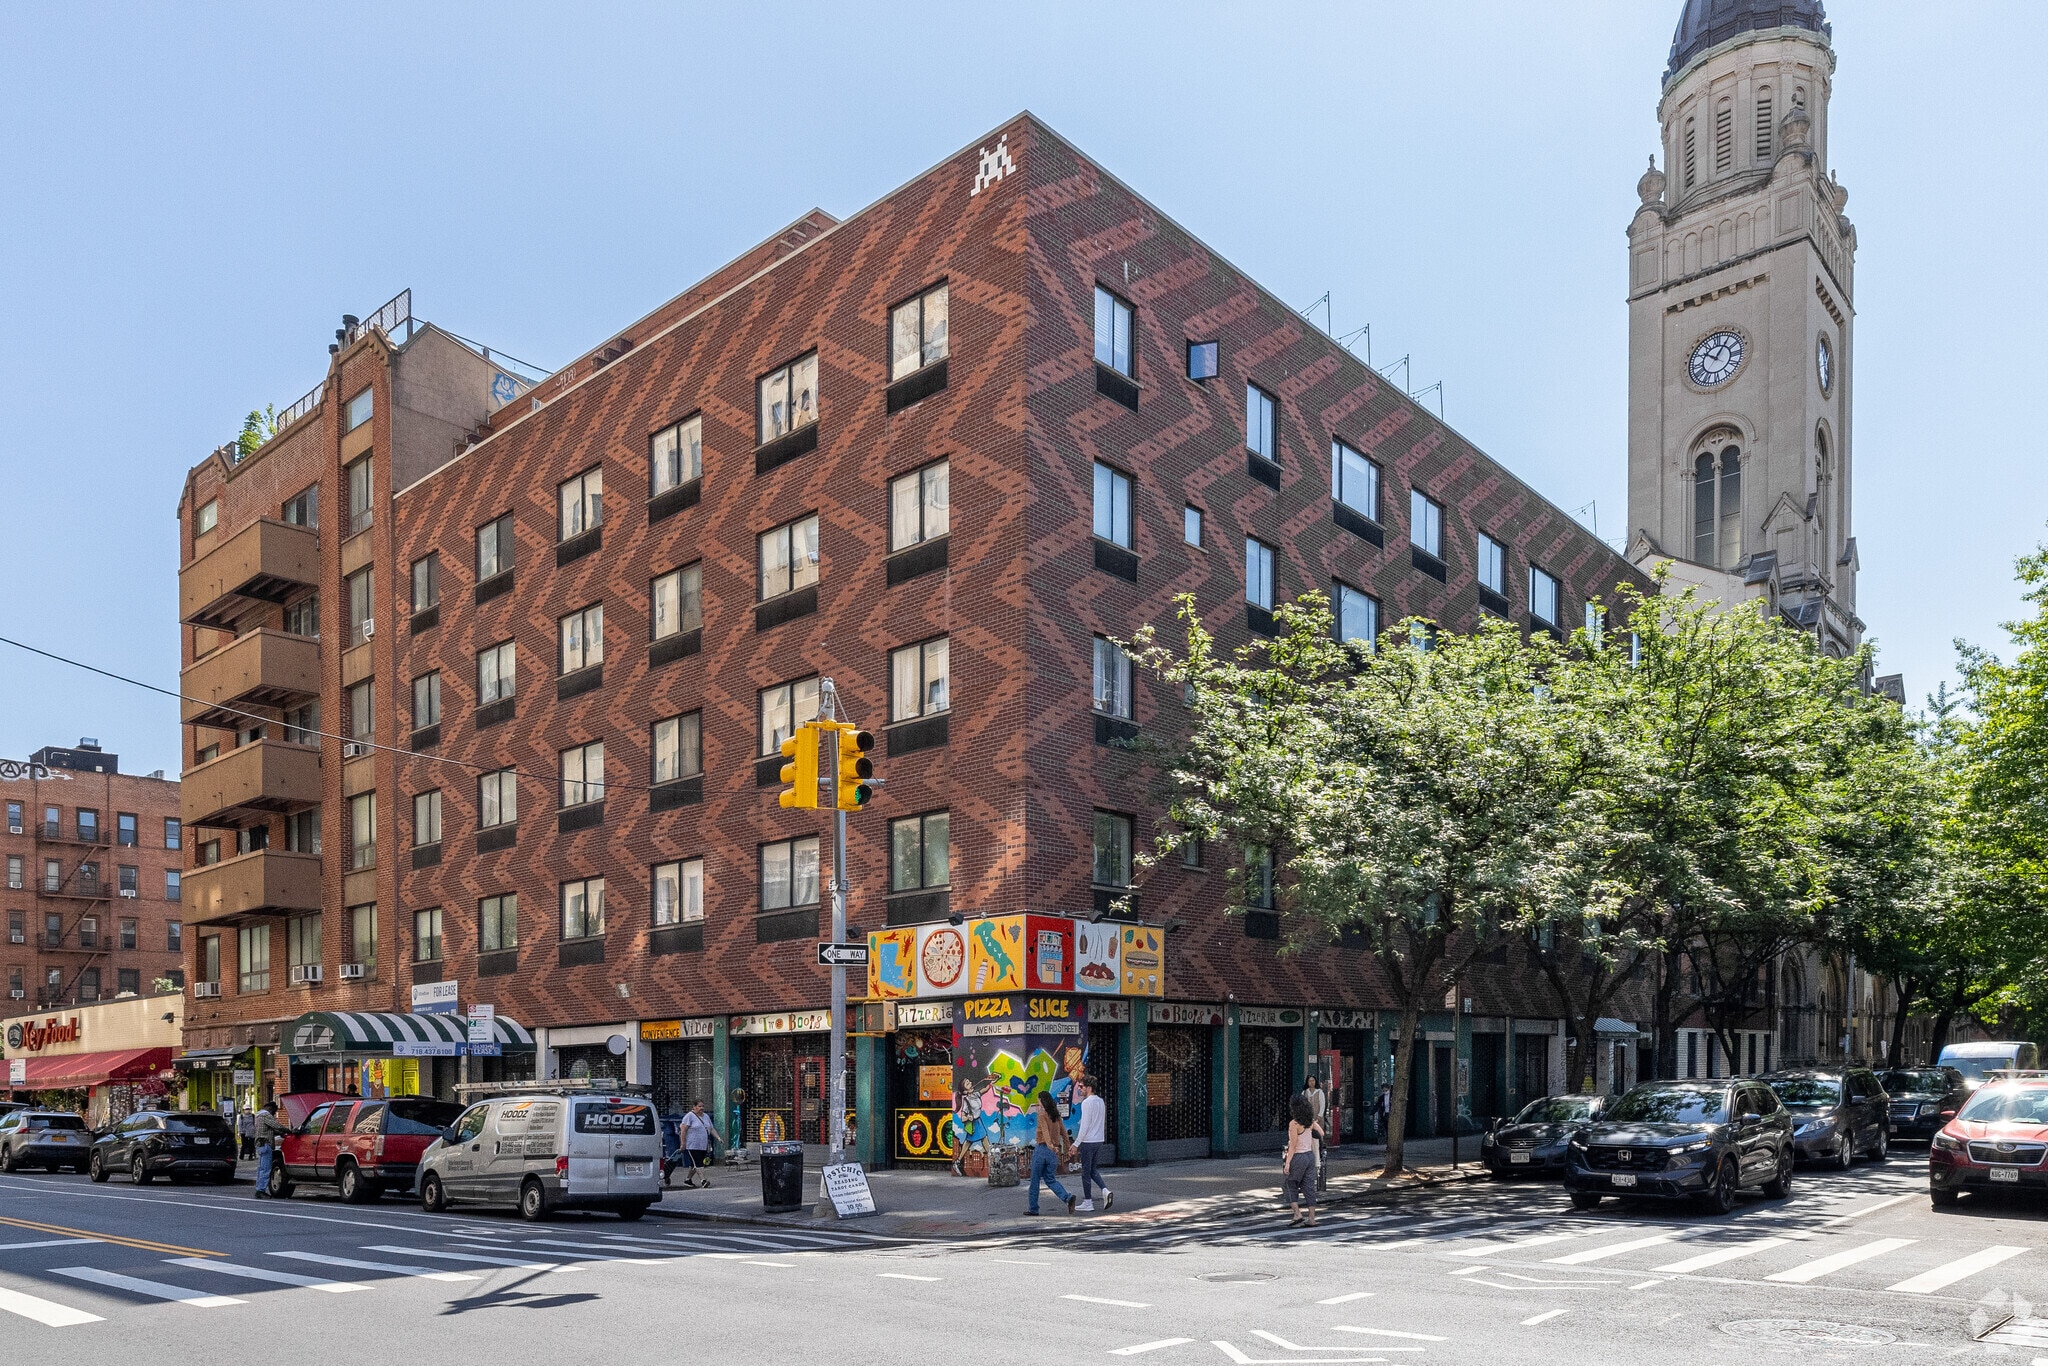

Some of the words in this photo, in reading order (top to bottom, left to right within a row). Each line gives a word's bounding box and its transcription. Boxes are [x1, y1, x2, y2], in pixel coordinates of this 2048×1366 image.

[982, 930, 1002, 959] ITALY
[827, 950, 841, 958] ONE
[850, 950, 864, 958] WAY
[434, 986, 442, 997] FOR
[443, 985, 456, 996] LEASE
[964, 998, 1012, 1020] PIZZA
[1029, 998, 1069, 1018] SLICE
[22, 1021, 44, 1051] Key
[44, 1017, 77, 1044] Food
[641, 1028, 680, 1039] CONVENIENCE
[976, 1025, 1002, 1034] AVENUE
[1007, 1024, 1012, 1032] A
[501, 1110, 528, 1118] HOODZ
[584, 1114, 645, 1125] HOODZ
[827, 1166, 862, 1180] PSYCHIC
